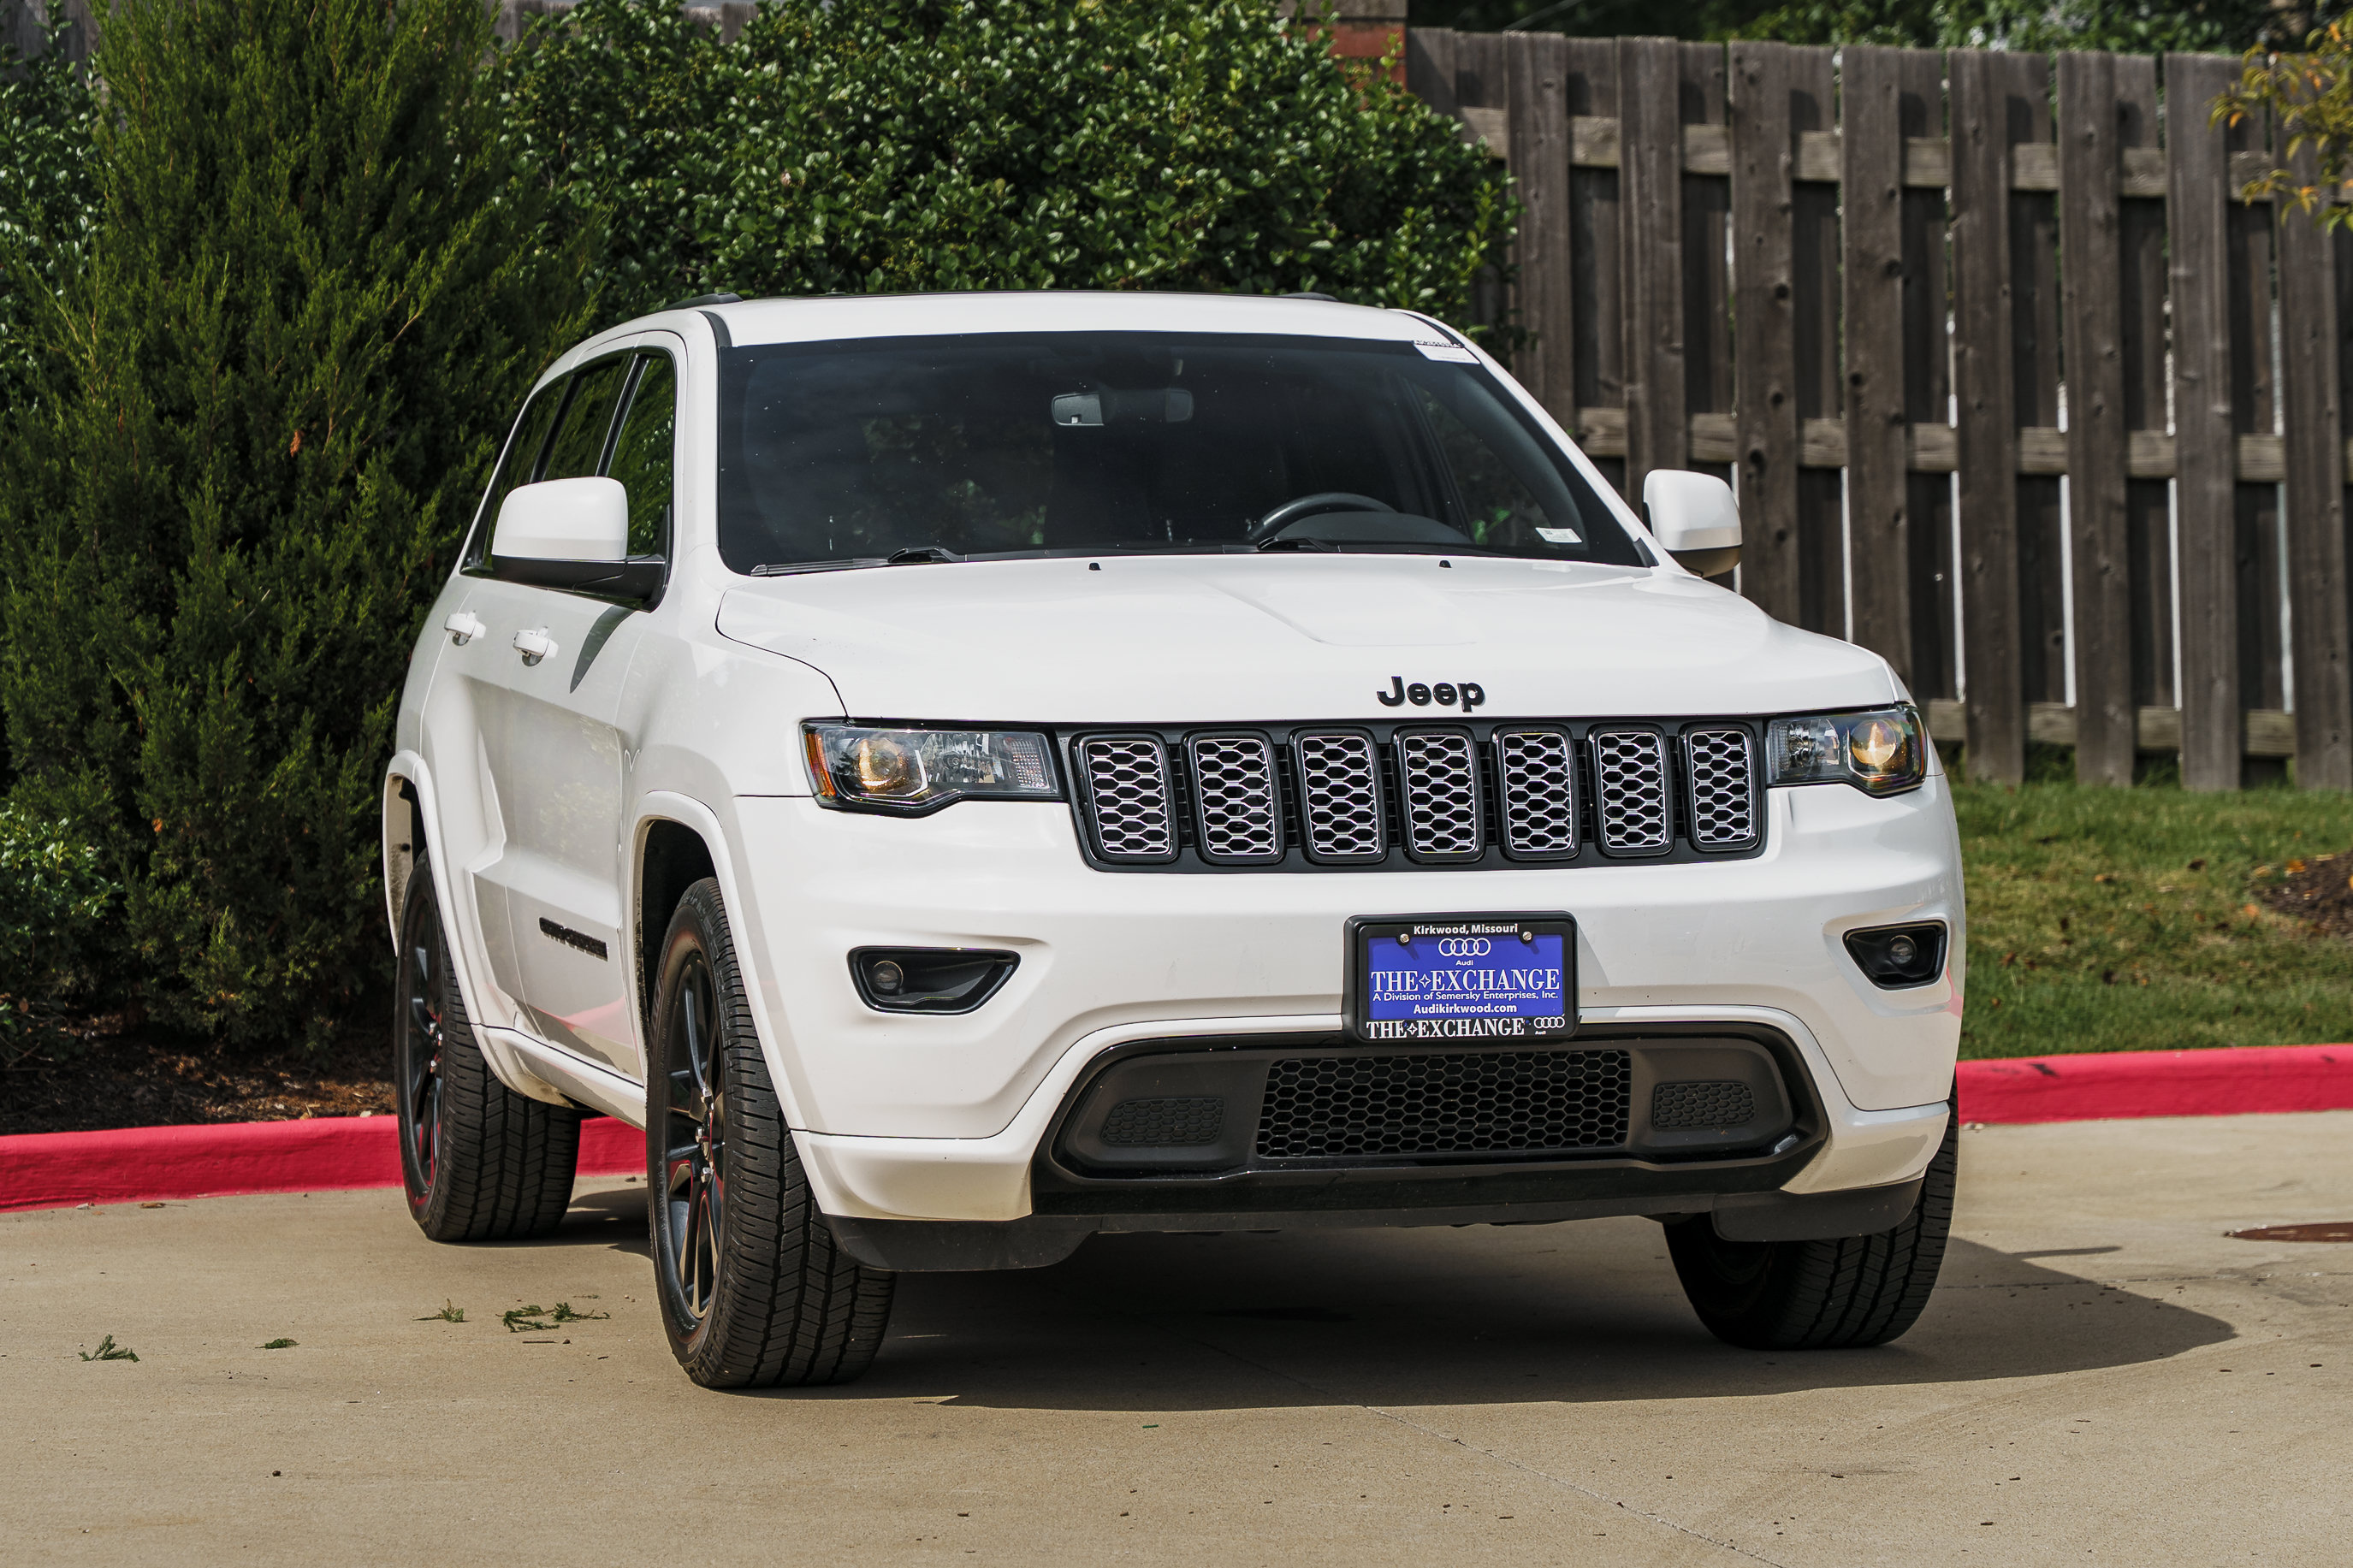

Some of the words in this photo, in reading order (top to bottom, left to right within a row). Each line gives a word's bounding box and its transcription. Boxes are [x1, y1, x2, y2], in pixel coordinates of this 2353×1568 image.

[1377, 676, 1485, 713] Jeep
[1414, 925, 1470, 935] Kirkwood,
[1471, 923, 1518, 933] Missouri
[1371, 970, 1419, 992] THE
[1430, 968, 1560, 991] EXCHANGE
[1384, 992, 1420, 1001] Division
[1423, 991, 1433, 1000] of
[1435, 991, 1480, 1002] Semersky
[1483, 991, 1539, 1001] Enterprises,
[1542, 990, 1558, 999] Inc.
[1413, 1003, 1517, 1014] Audikirkwood.com
[1366, 1020, 1408, 1038] THE
[1416, 1017, 1525, 1038] EXCHANGE
